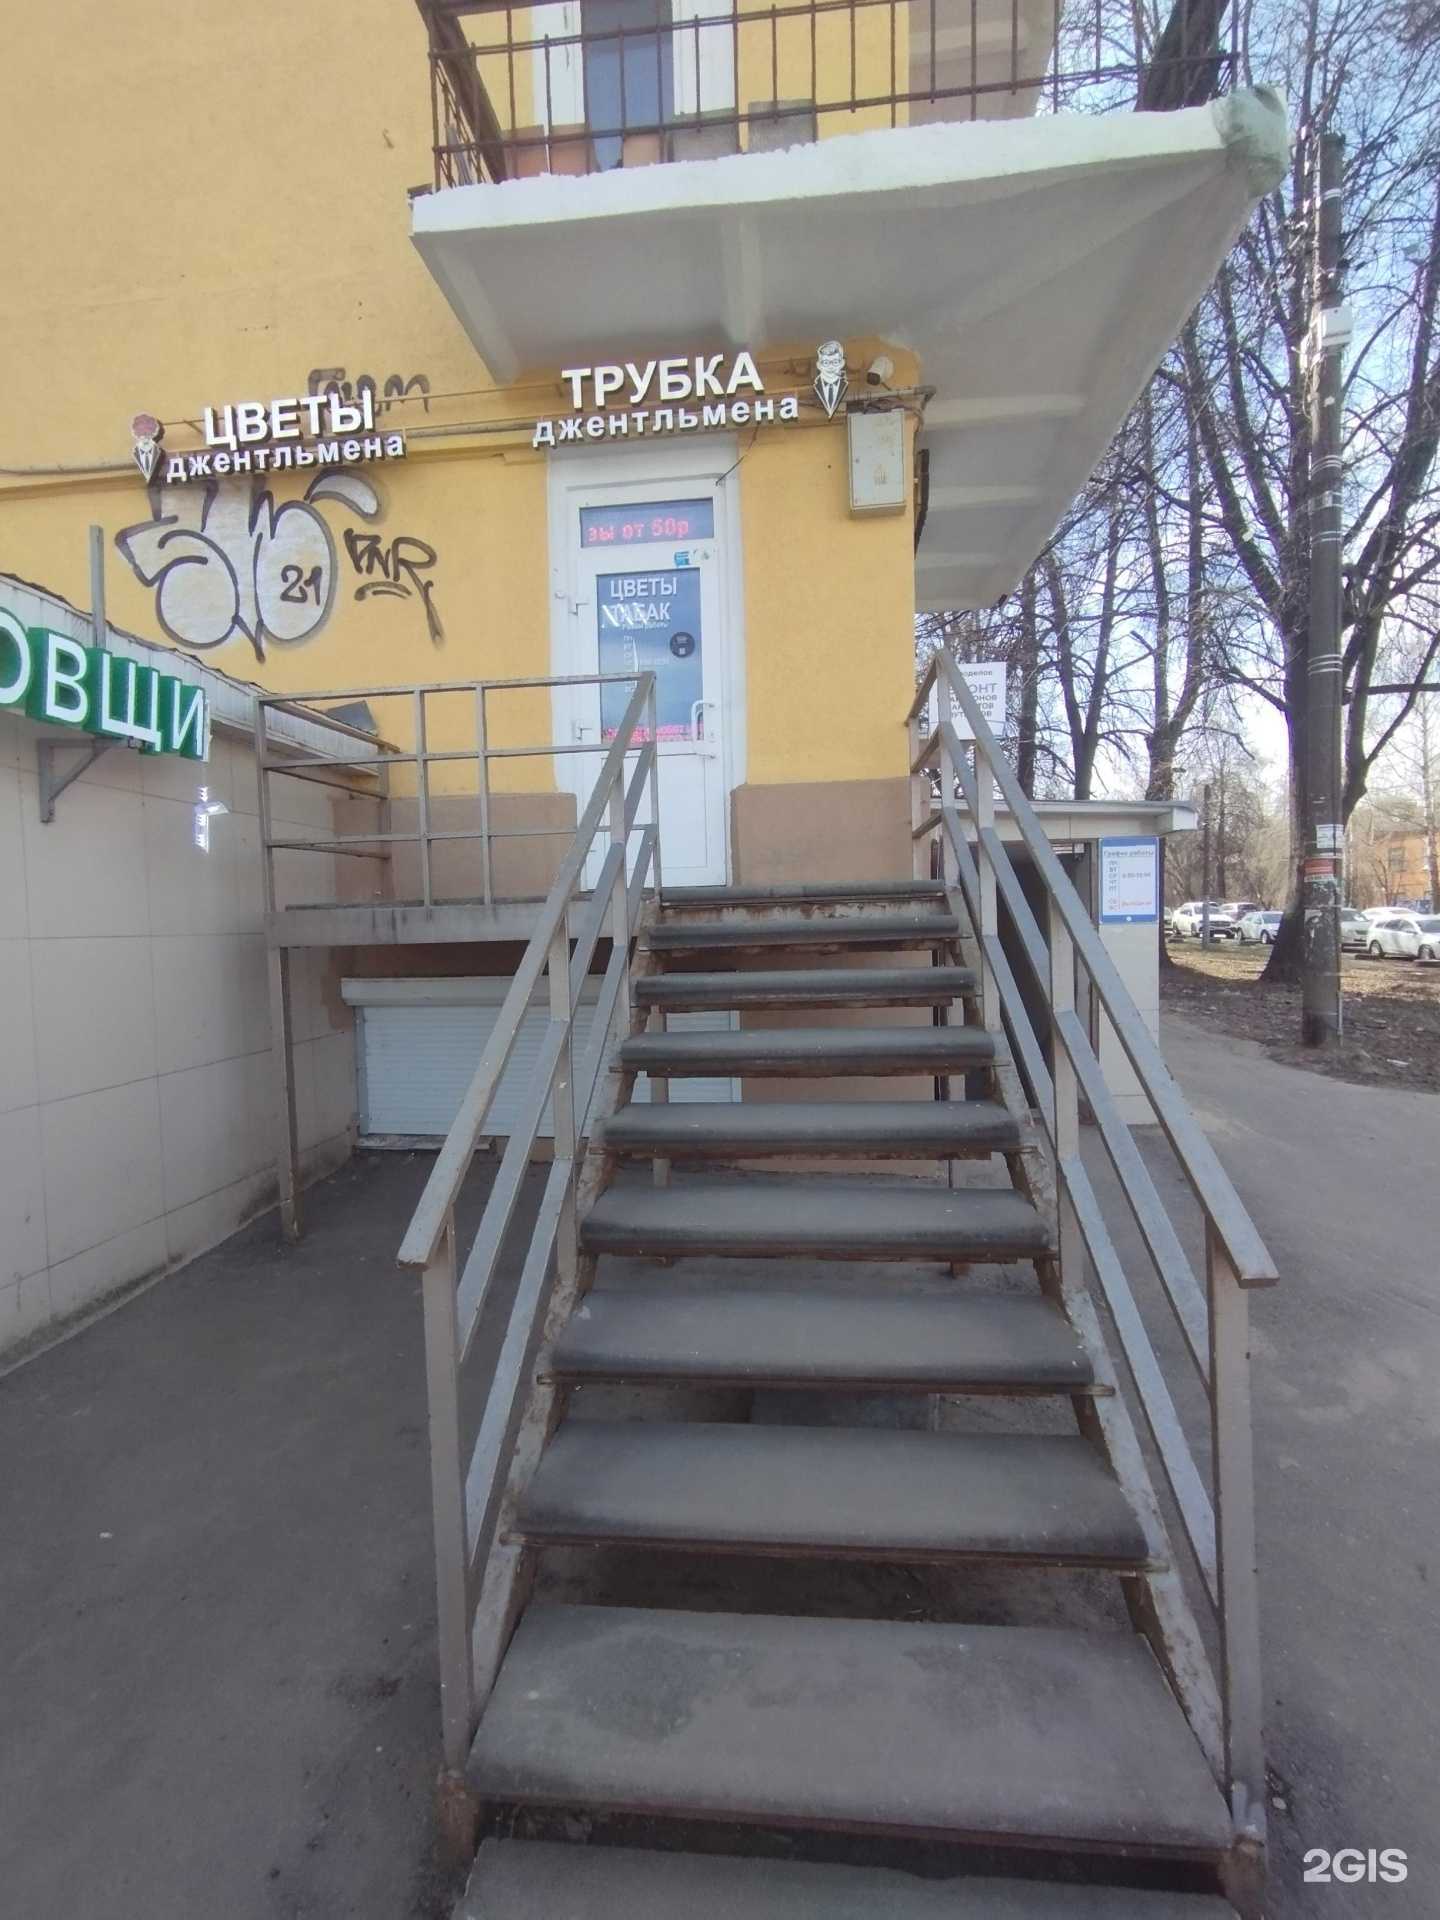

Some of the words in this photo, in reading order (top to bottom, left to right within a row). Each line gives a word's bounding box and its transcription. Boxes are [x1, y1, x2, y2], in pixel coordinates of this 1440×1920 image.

[562, 352, 764, 409] ТРУБКА
[203, 389, 375, 450] ЦВЕТЫ
[532, 394, 799, 448] джентльмена
[166, 434, 405, 483] джентльмена
[280, 564, 323, 606] 21
[610, 577, 678, 601] ЦВЕТЫ
